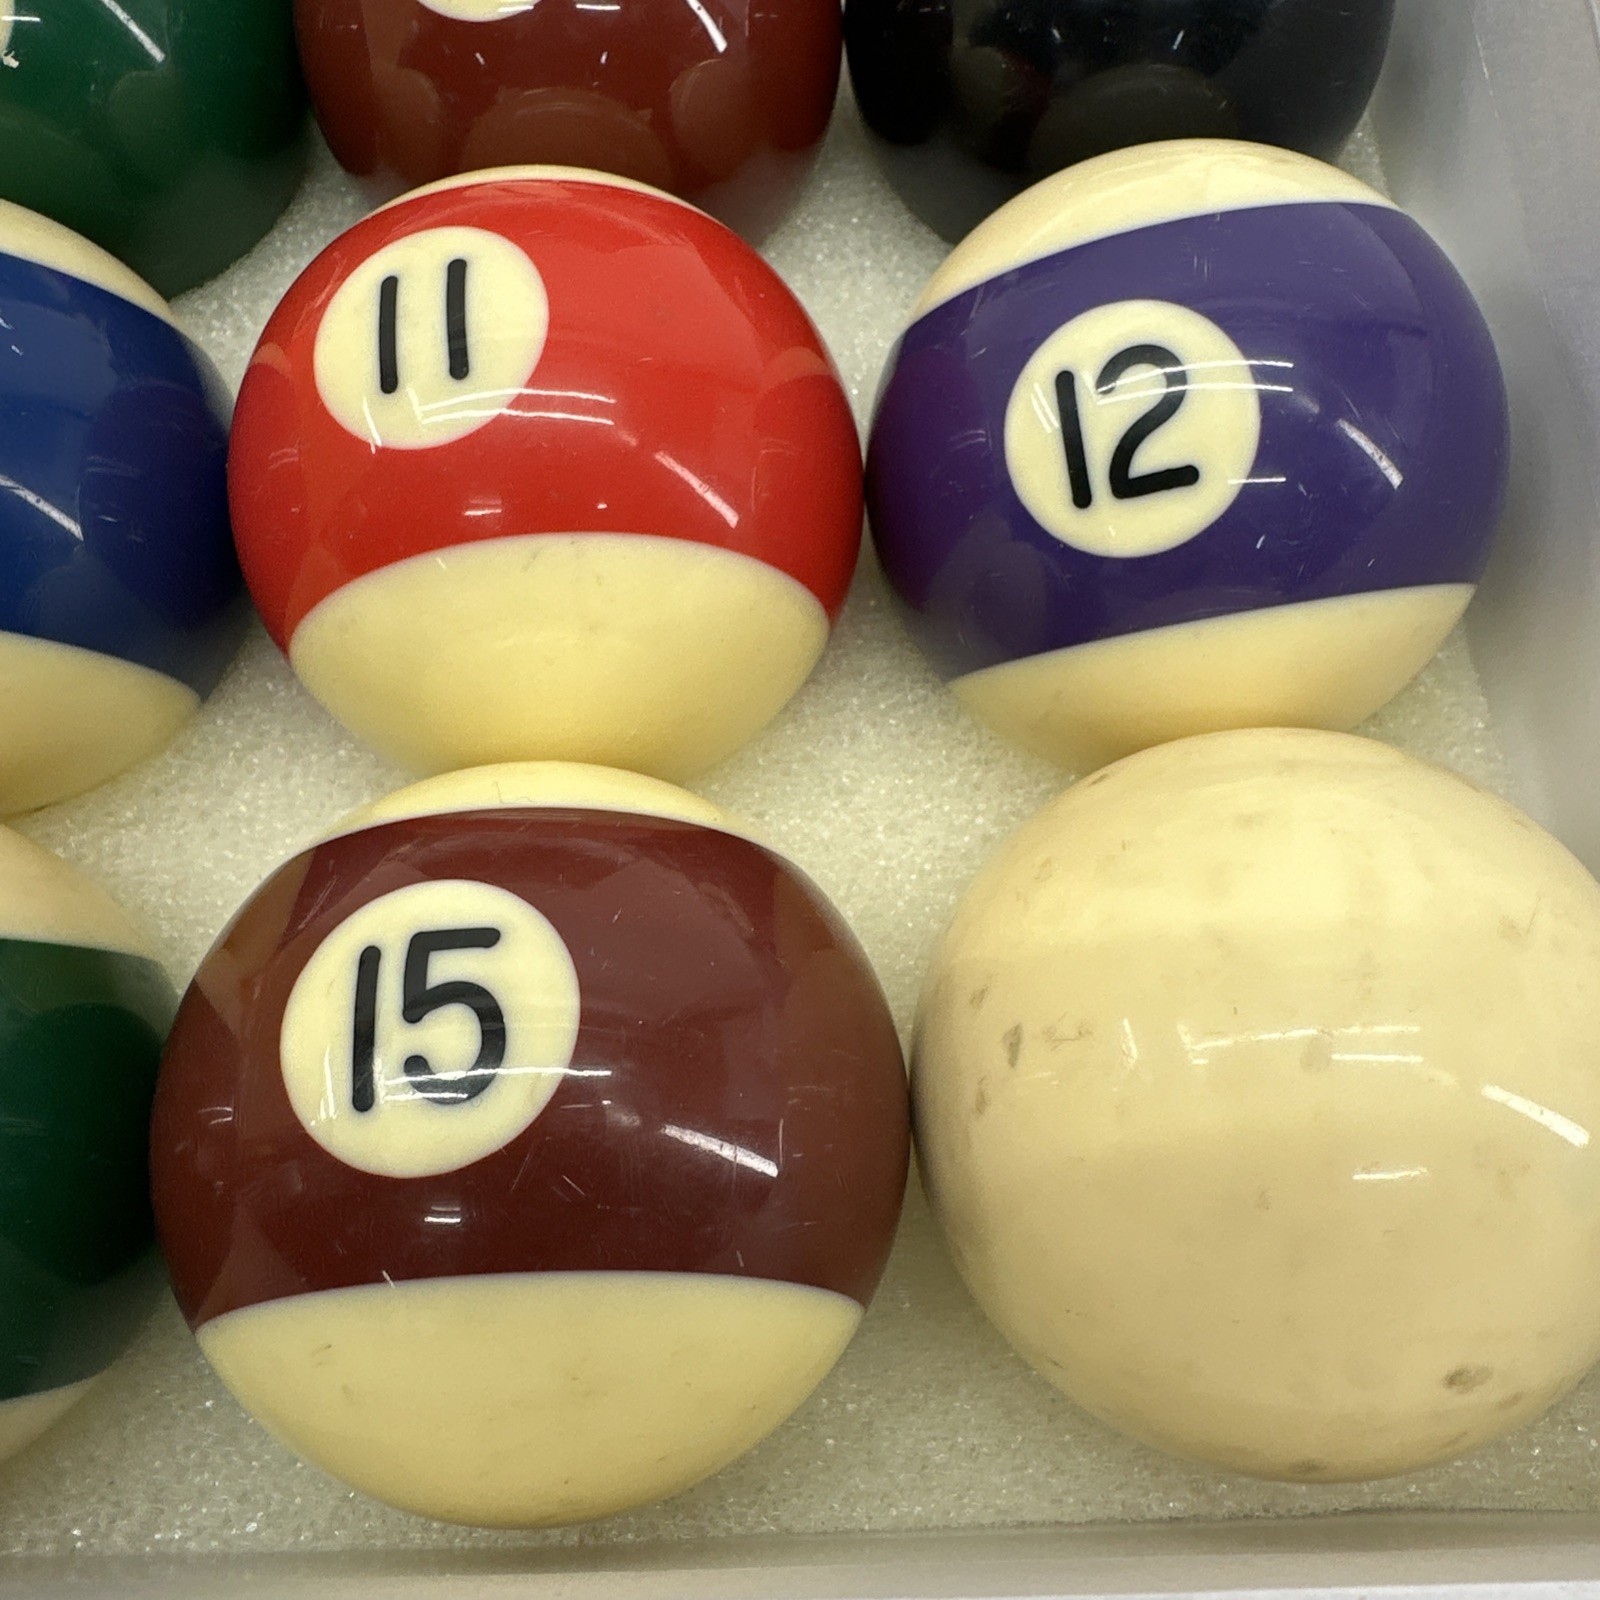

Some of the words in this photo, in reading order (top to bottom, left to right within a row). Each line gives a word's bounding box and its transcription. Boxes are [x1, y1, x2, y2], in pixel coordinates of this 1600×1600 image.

[378, 258, 470, 395] 11
[1054, 344, 1201, 511] 12
[351, 927, 507, 1115] 15
